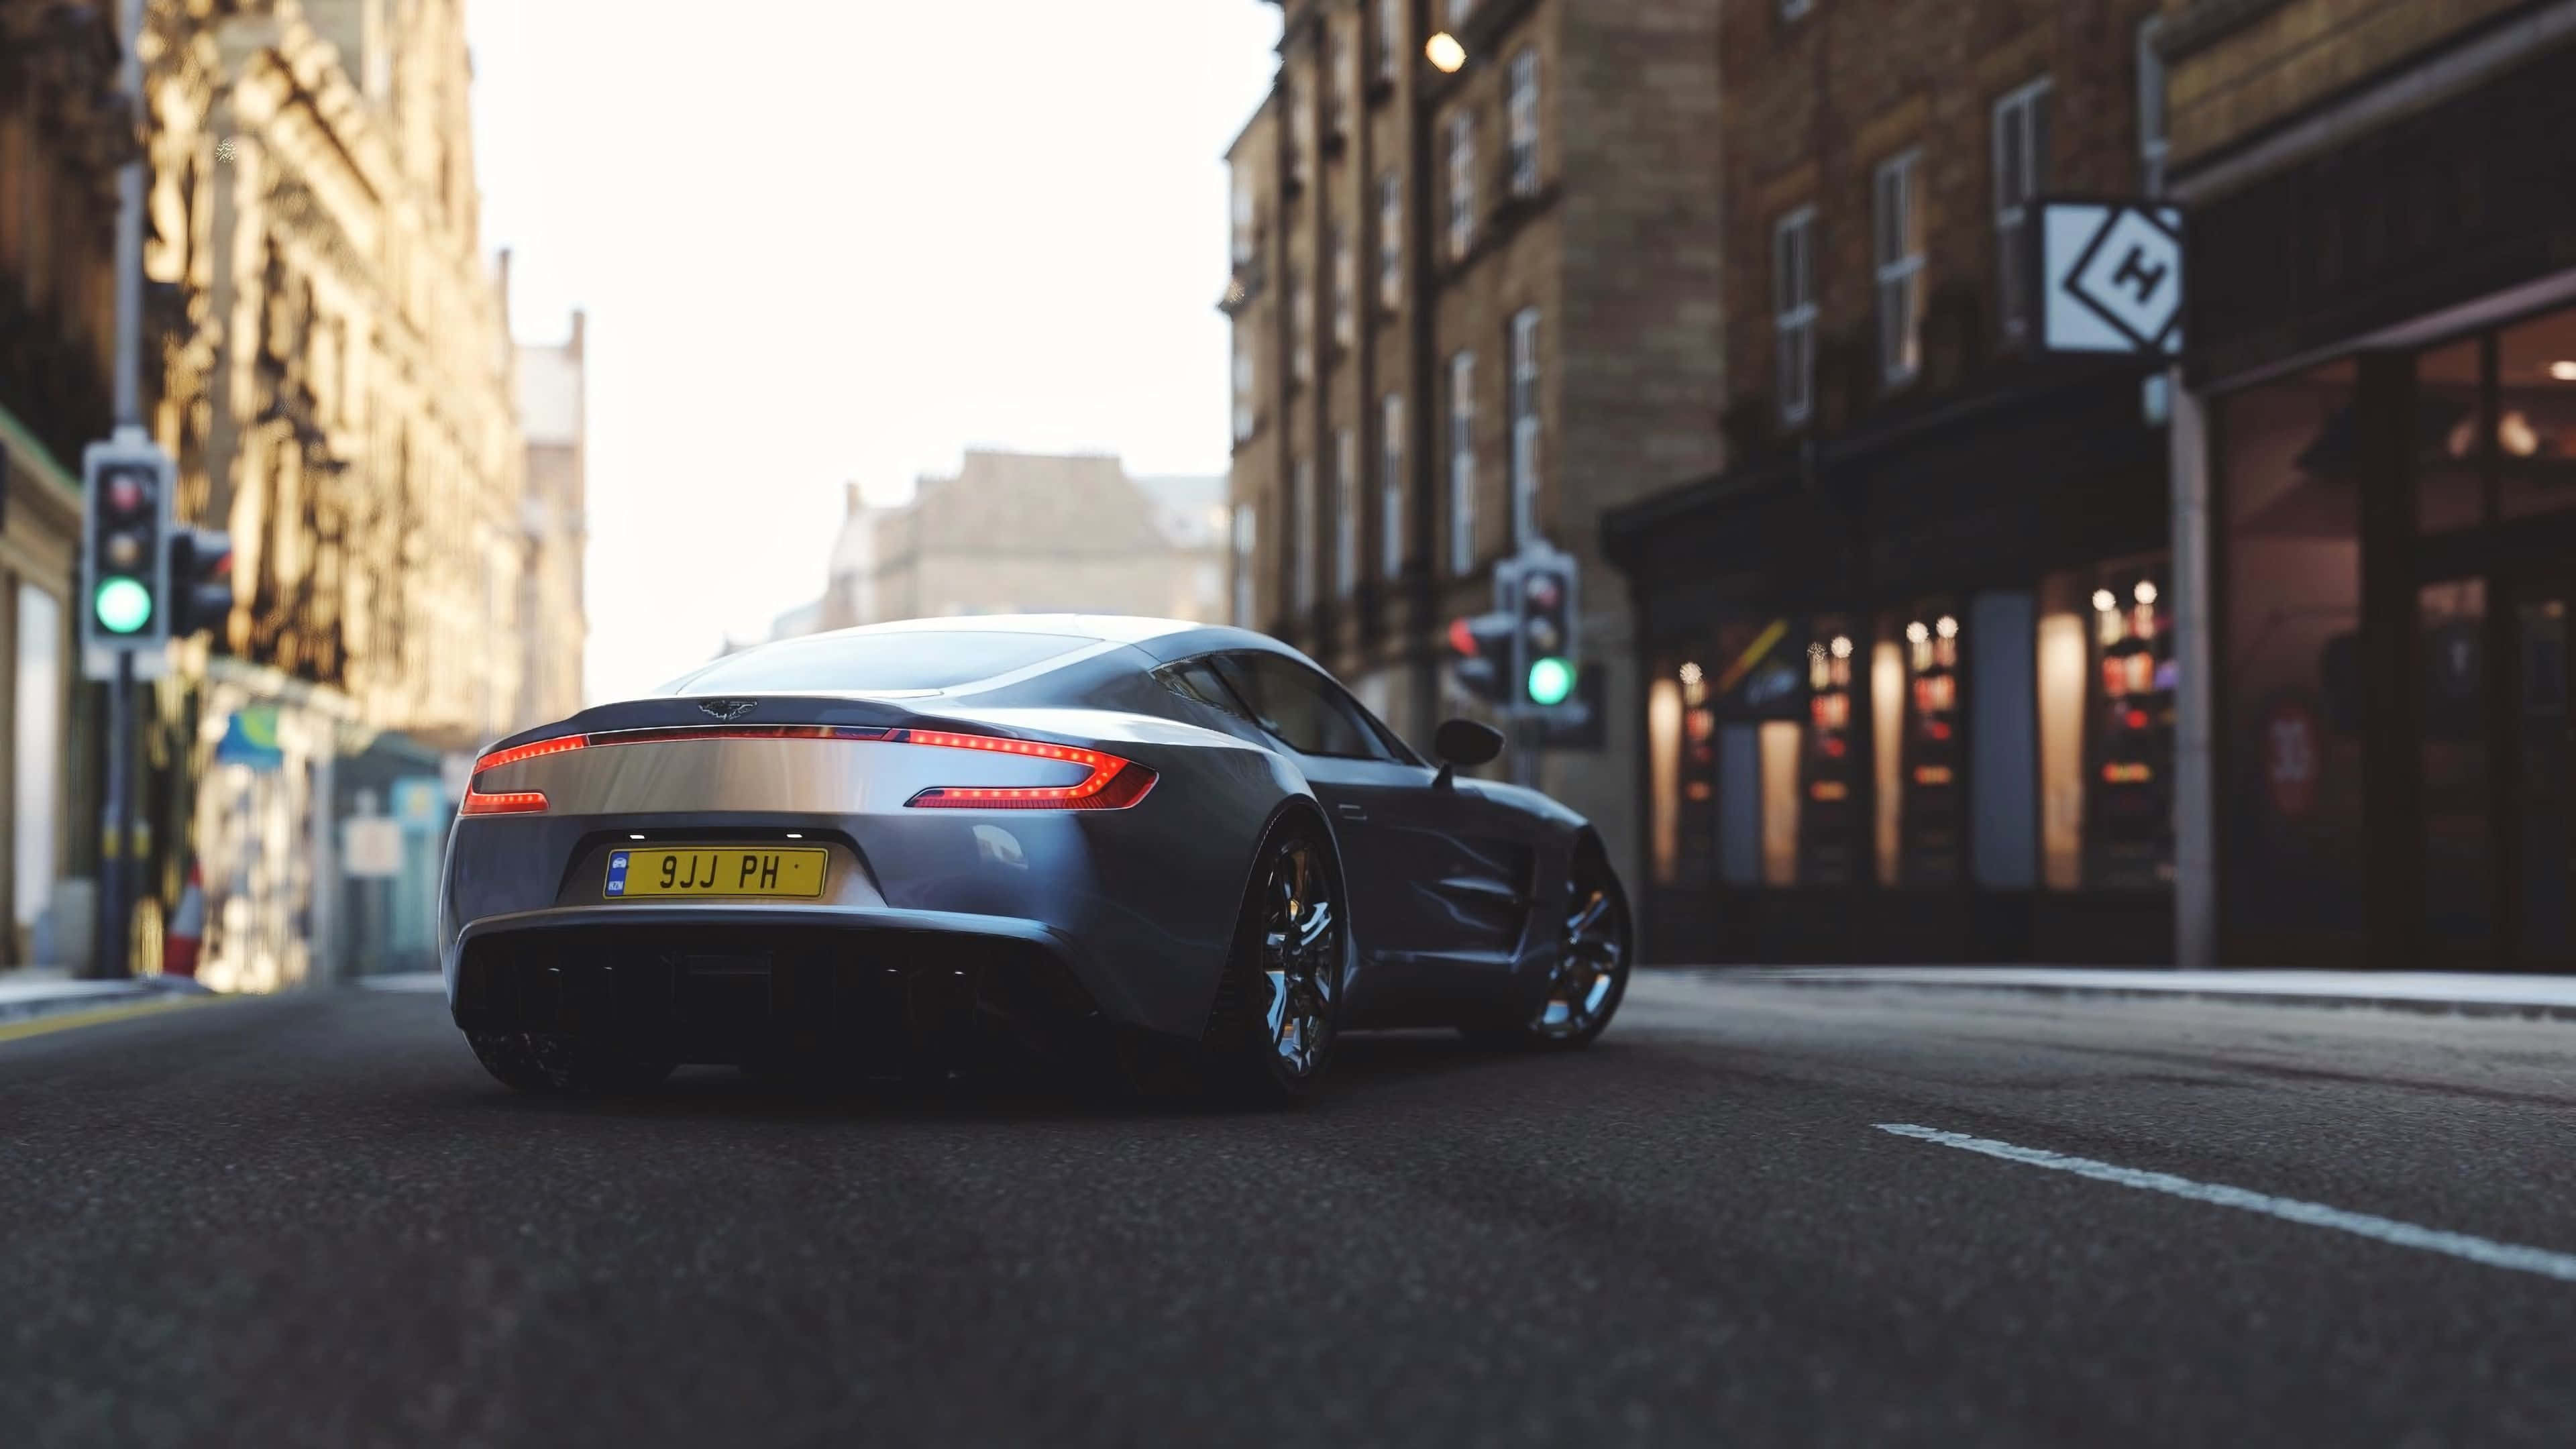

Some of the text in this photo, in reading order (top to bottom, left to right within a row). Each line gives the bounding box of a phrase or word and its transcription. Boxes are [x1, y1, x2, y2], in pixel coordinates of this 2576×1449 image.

[2112, 244, 2166, 305] H
[660, 855, 780, 889] 9JJ PH
